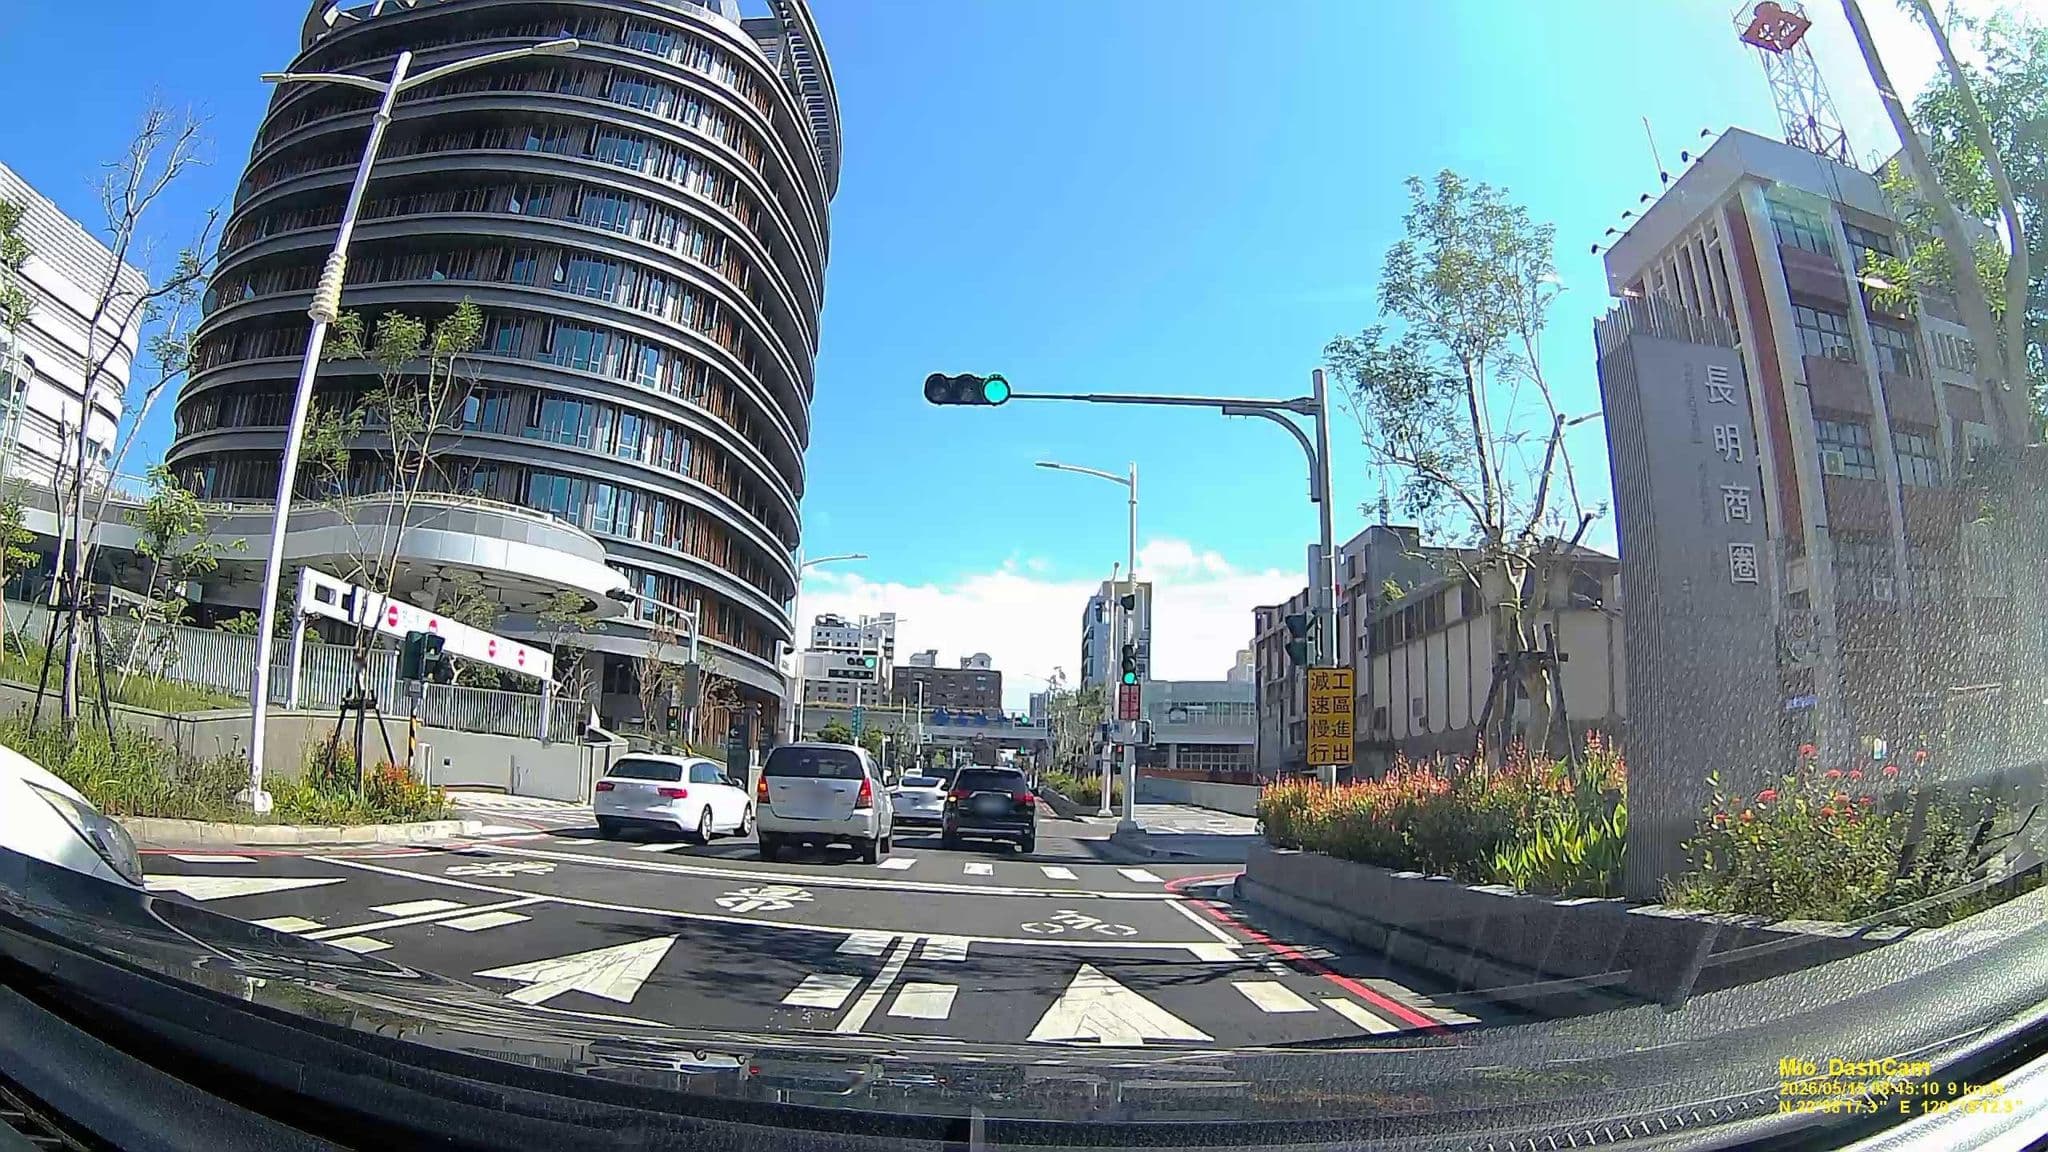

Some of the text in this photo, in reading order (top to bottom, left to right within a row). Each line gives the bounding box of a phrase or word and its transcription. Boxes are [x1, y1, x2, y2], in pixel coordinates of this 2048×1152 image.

[1704, 364, 1759, 585] 長明商圈
[1310, 672, 1330, 762] 減速慢行
[1332, 672, 1351, 761] 工區進出
